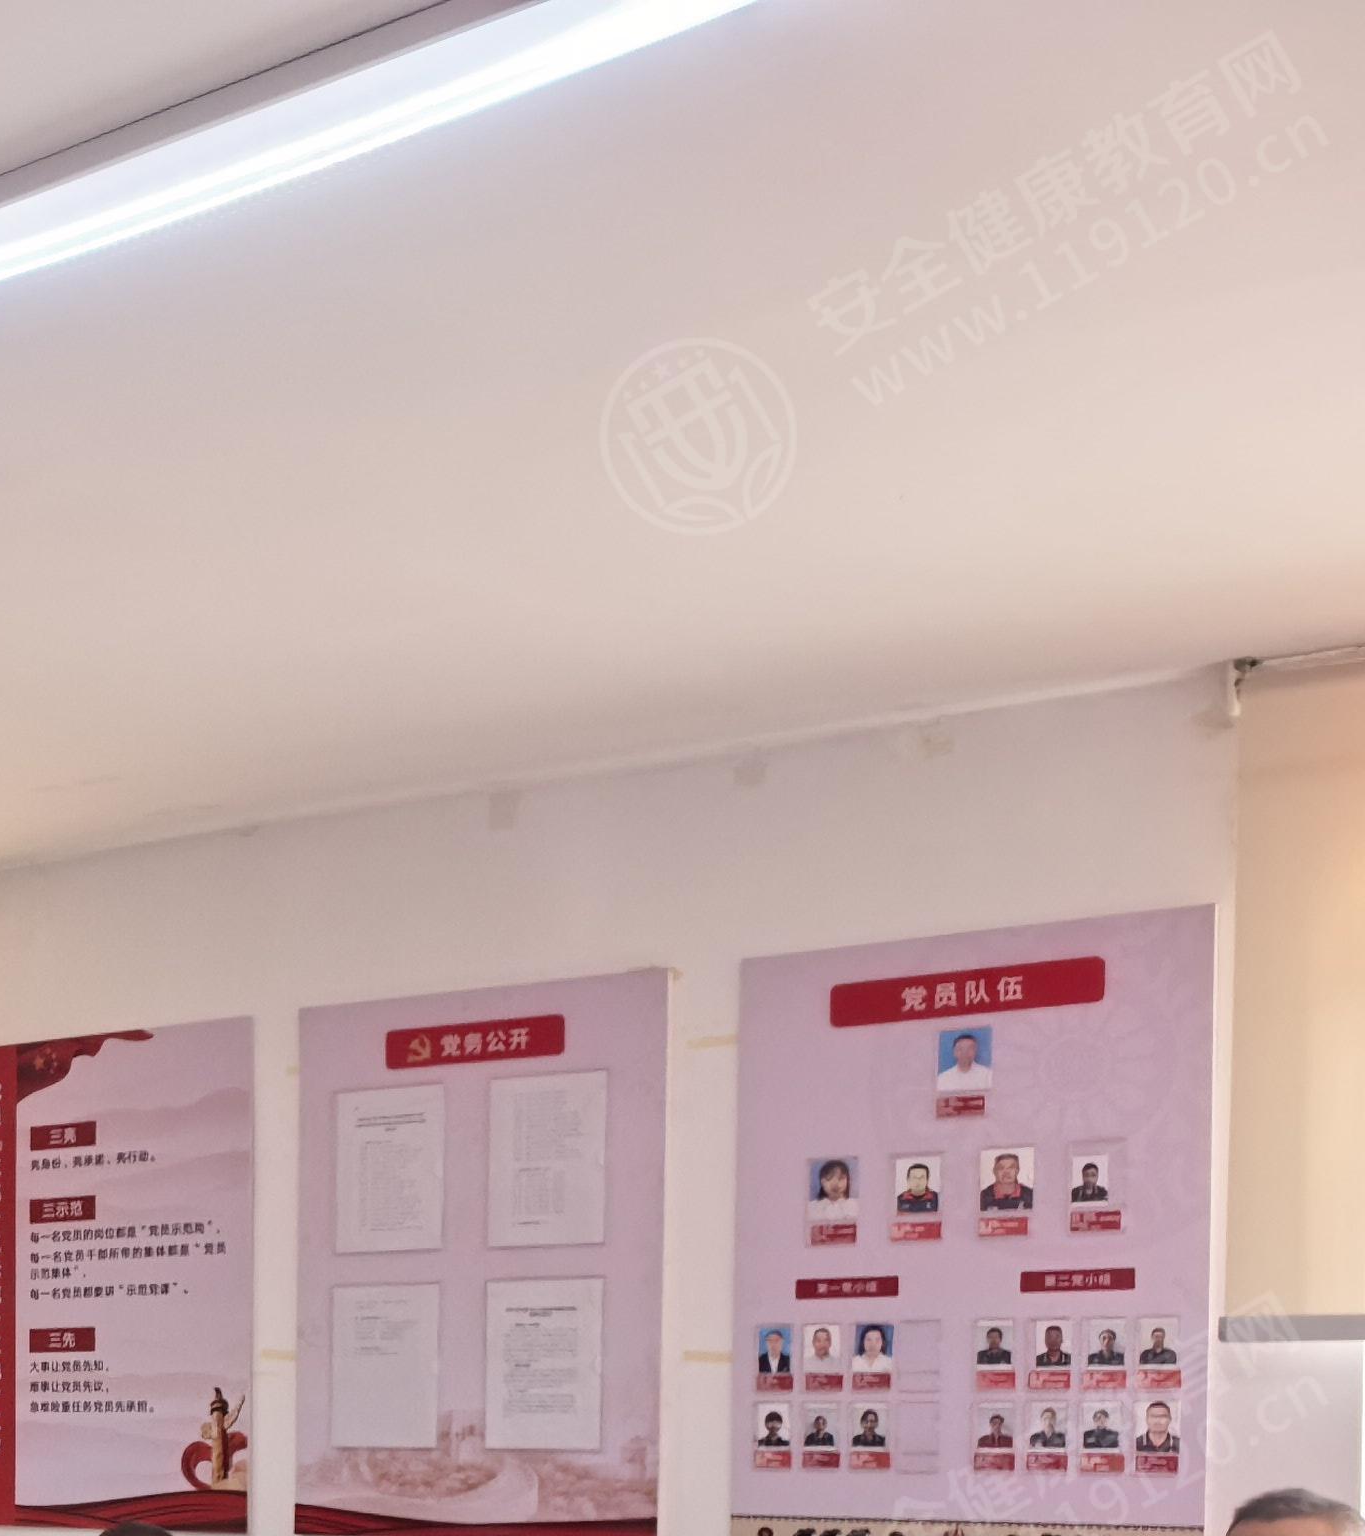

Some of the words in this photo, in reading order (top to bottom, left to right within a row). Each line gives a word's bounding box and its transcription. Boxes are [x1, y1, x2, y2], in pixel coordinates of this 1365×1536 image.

[901, 975, 1024, 1012] 党员队伍
[440, 1027, 530, 1057] 党务公开
[49, 1126, 77, 1144] 三亮
[42, 1200, 83, 1219] 三示范
[48, 1331, 76, 1349] 三先
